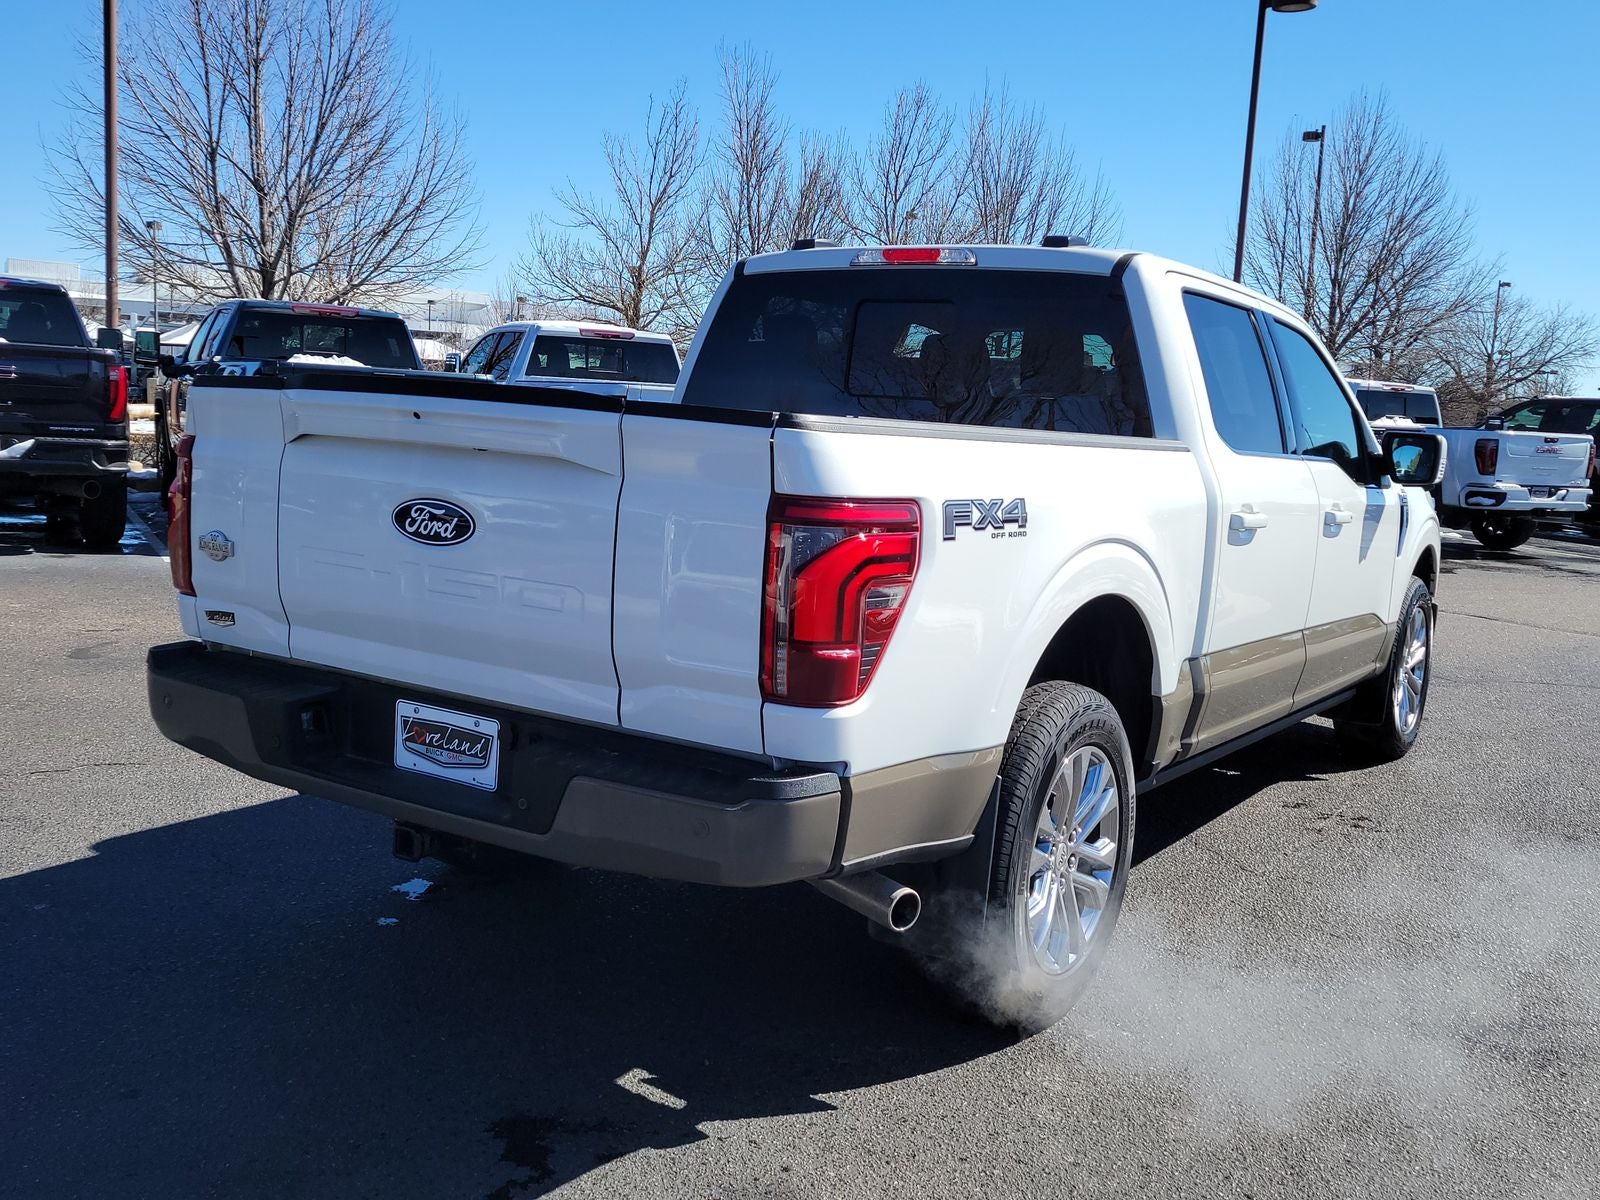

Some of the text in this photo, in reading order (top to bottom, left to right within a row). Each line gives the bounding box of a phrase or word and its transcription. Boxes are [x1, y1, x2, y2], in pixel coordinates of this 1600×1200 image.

[405, 505, 458, 538] Ford
[942, 498, 1027, 540] FX4
[1008, 530, 1028, 538] ROAD
[425, 747, 463, 762] BUICK GMC
